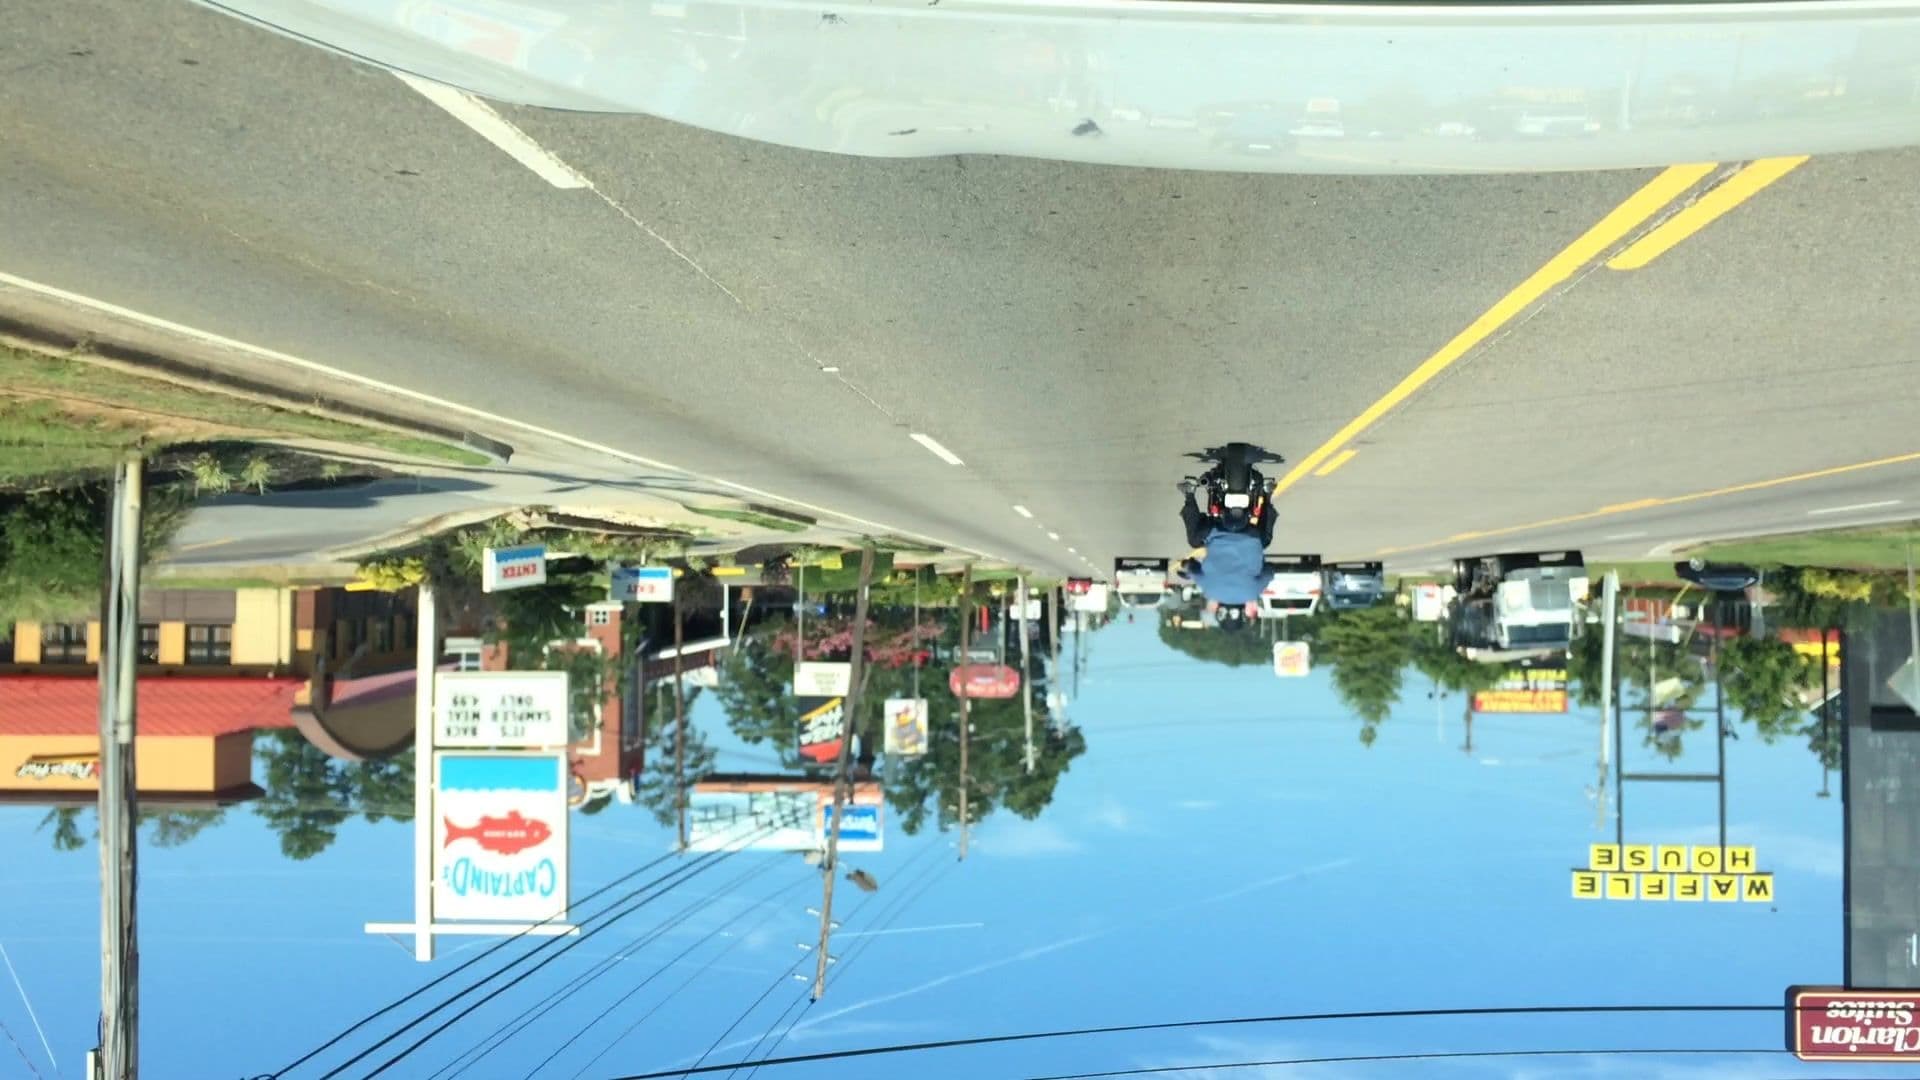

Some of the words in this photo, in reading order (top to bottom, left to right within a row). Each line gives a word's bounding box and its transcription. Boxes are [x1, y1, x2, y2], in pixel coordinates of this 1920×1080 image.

[501, 563, 538, 579] ENTER
[499, 695, 534, 707] ONLY
[447, 710, 480, 722] MEAL
[490, 710, 552, 722] SAMPLER
[445, 726, 478, 738] BACK
[1596, 848, 1750, 868] HOUSE
[1578, 876, 1768, 896] WAFFLE
[1810, 1025, 1920, 1052] Clarion
